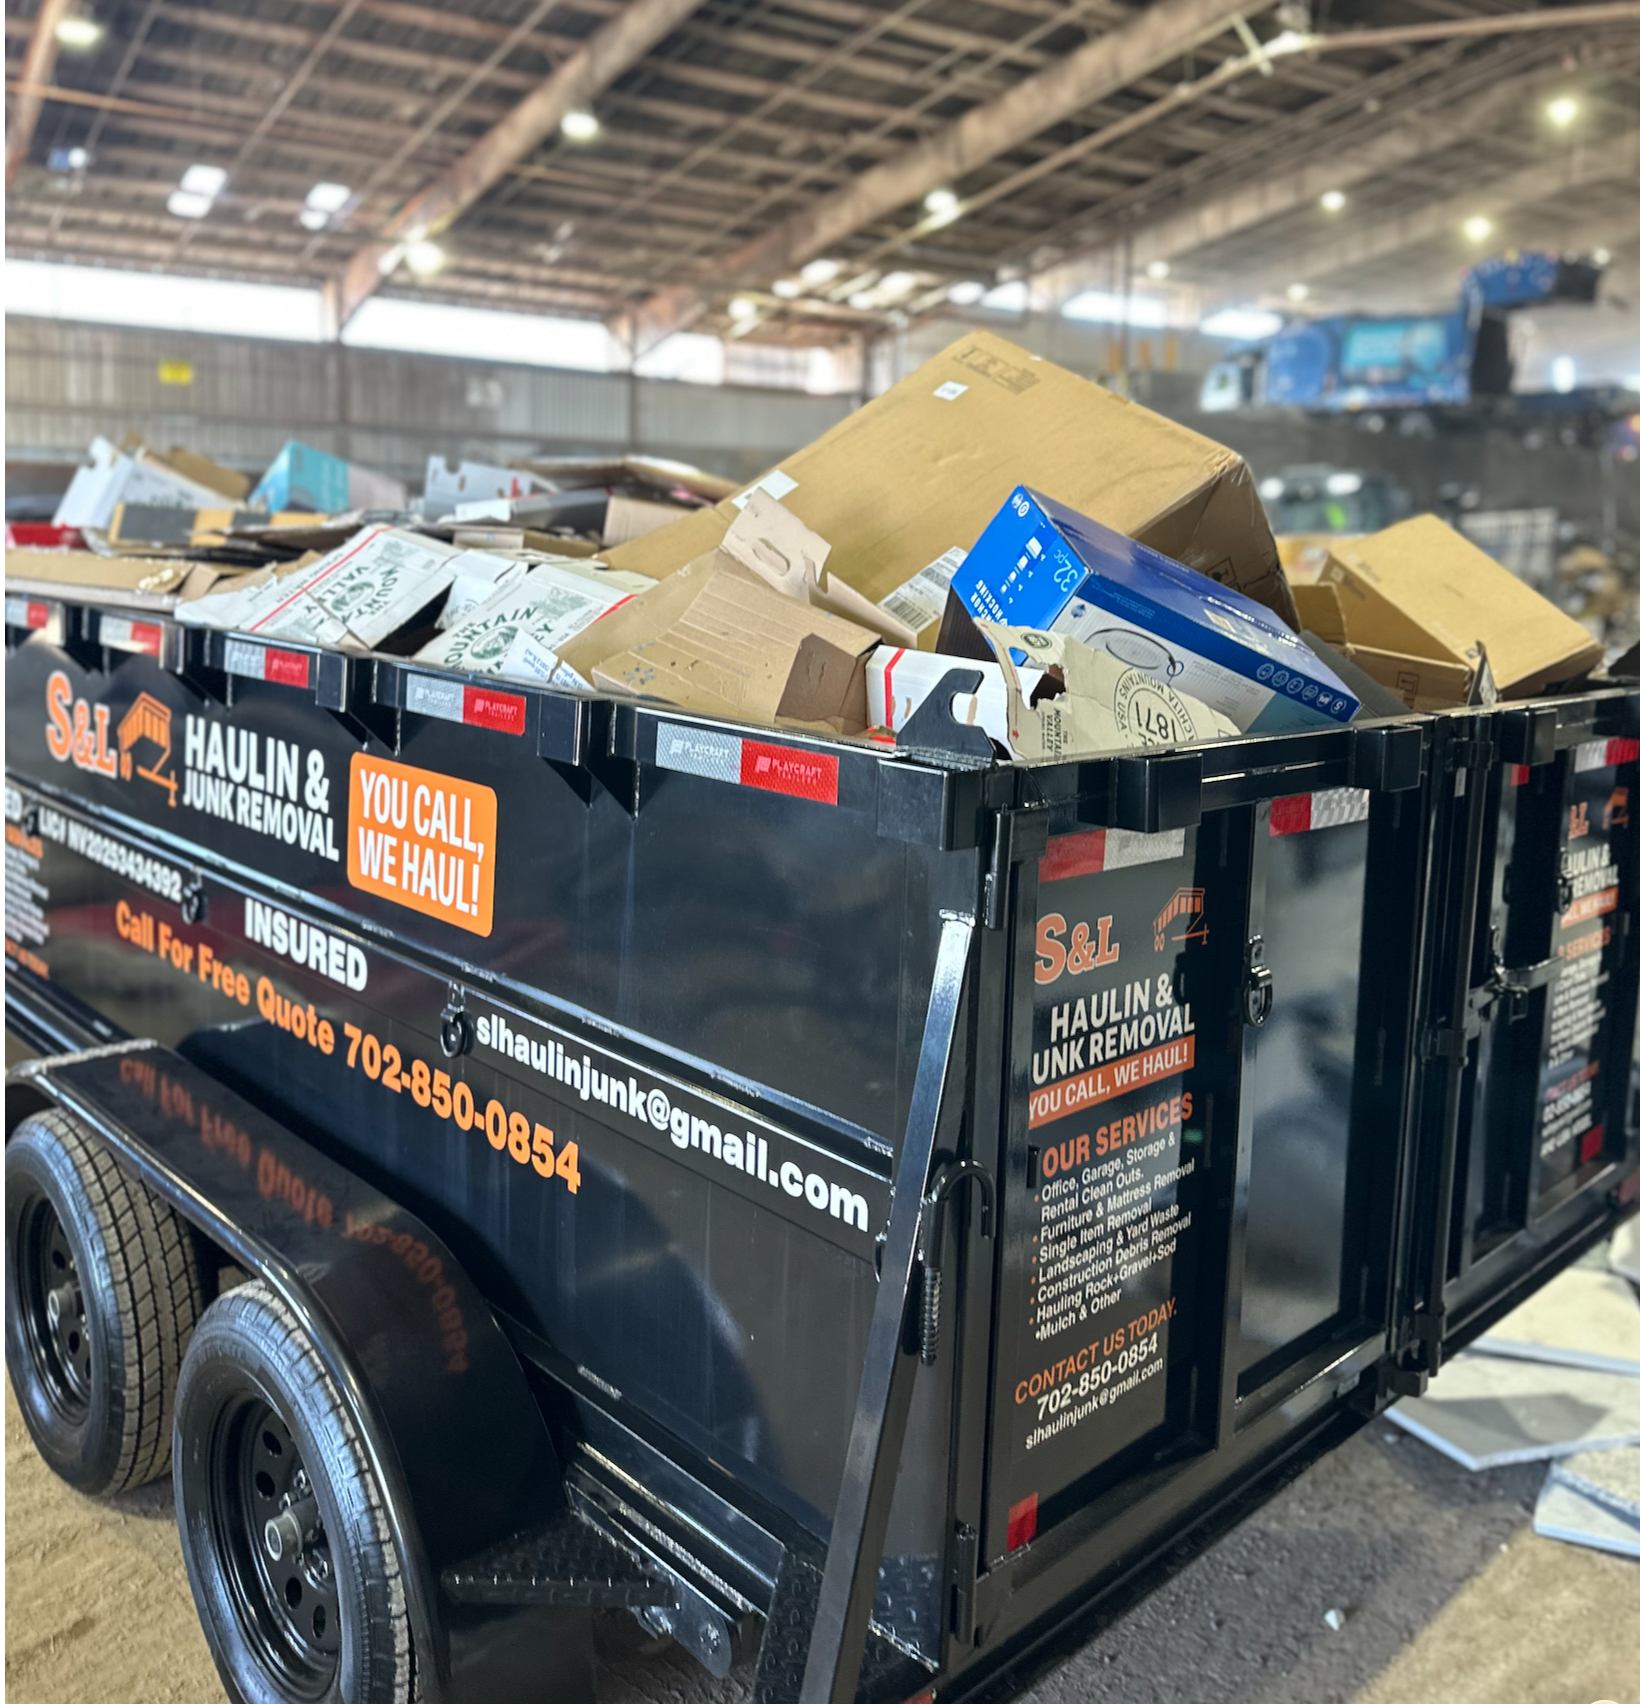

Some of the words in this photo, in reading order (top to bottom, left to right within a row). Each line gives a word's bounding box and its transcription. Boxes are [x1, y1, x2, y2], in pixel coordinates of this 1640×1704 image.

[970, 592, 994, 622] NCHOR
[976, 580, 1004, 620] HOCKING
[46, 670, 117, 779] S&L
[484, 699, 518, 716] PLAYCRAFT
[185, 713, 299, 802] HAULIN
[305, 749, 330, 813] &
[772, 758, 822, 778] PLAYCRAFT
[182, 769, 234, 822] JUNK
[237, 786, 340, 862] REMOVAL
[360, 768, 408, 830] YOU
[414, 784, 484, 863] CALL,
[358, 826, 397, 886] WE
[402, 840, 480, 917] HAUL!
[1567, 846, 1600, 875] AULIN
[245, 897, 368, 992] INSURED
[1035, 913, 1120, 985] S&L
[116, 900, 154, 952] Call
[158, 921, 193, 974] For
[198, 943, 250, 1006] Free
[256, 976, 335, 1055] Quote
[344, 1022, 582, 1195] 702-850-0854
[1033, 1037, 1085, 1085] UNK
[1089, 1003, 1195, 1066] REMOVAL
[1051, 978, 1151, 1043] HAULIN
[1156, 973, 1173, 1007] &
[475, 1014, 870, 1232] slhaulinjunk@gmail.com
[1029, 1089, 1061, 1121] YOU
[1065, 1073, 1111, 1106] CALL,
[1114, 1059, 1140, 1088] WE
[1143, 1043, 1188, 1078] HAUL!
[1041, 1176, 1079, 1202] Office,
[1082, 1157, 1124, 1184] Garage,
[1126, 1137, 1166, 1165] Storage
[1168, 1131, 1176, 1147] &
[1042, 1134, 1090, 1178] OUR
[1095, 1092, 1193, 1156] SERVICES
[1039, 1234, 1077, 1263] Single
[1080, 1223, 1104, 1245] Item
[1107, 1196, 1152, 1232] Removal
[1040, 1208, 1093, 1244] Furniture
[1096, 1201, 1104, 1218] &
[1107, 1182, 1151, 1213] Mattress
[1154, 1157, 1195, 1191] Removal
[1041, 1191, 1079, 1223] Rental
[1082, 1180, 1113, 1205] Clean
[1116, 1168, 1144, 1188] Outs.
[1037, 1256, 1113, 1303] Construction
[1115, 1237, 1149, 1266] Debris
[1151, 1211, 1192, 1246] Removal
[1039, 1237, 1113, 1284] Landscaping
[1116, 1230, 1124, 1247] &
[1126, 1217, 1149, 1241] Yard
[1150, 1204, 1180, 1228] Waste
[1036, 1290, 1083, 1324] Hauling
[1079, 1304, 1087, 1321] &
[1091, 1288, 1122, 1314] Other
[1014, 1341, 1100, 1405] CONTACT
[1103, 1328, 1125, 1356] US
[1128, 1296, 1177, 1342] TODAY.
[1037, 1332, 1158, 1421] 702-850-0854
[1025, 1357, 1163, 1450] slhaulinjunk@gmail.com
